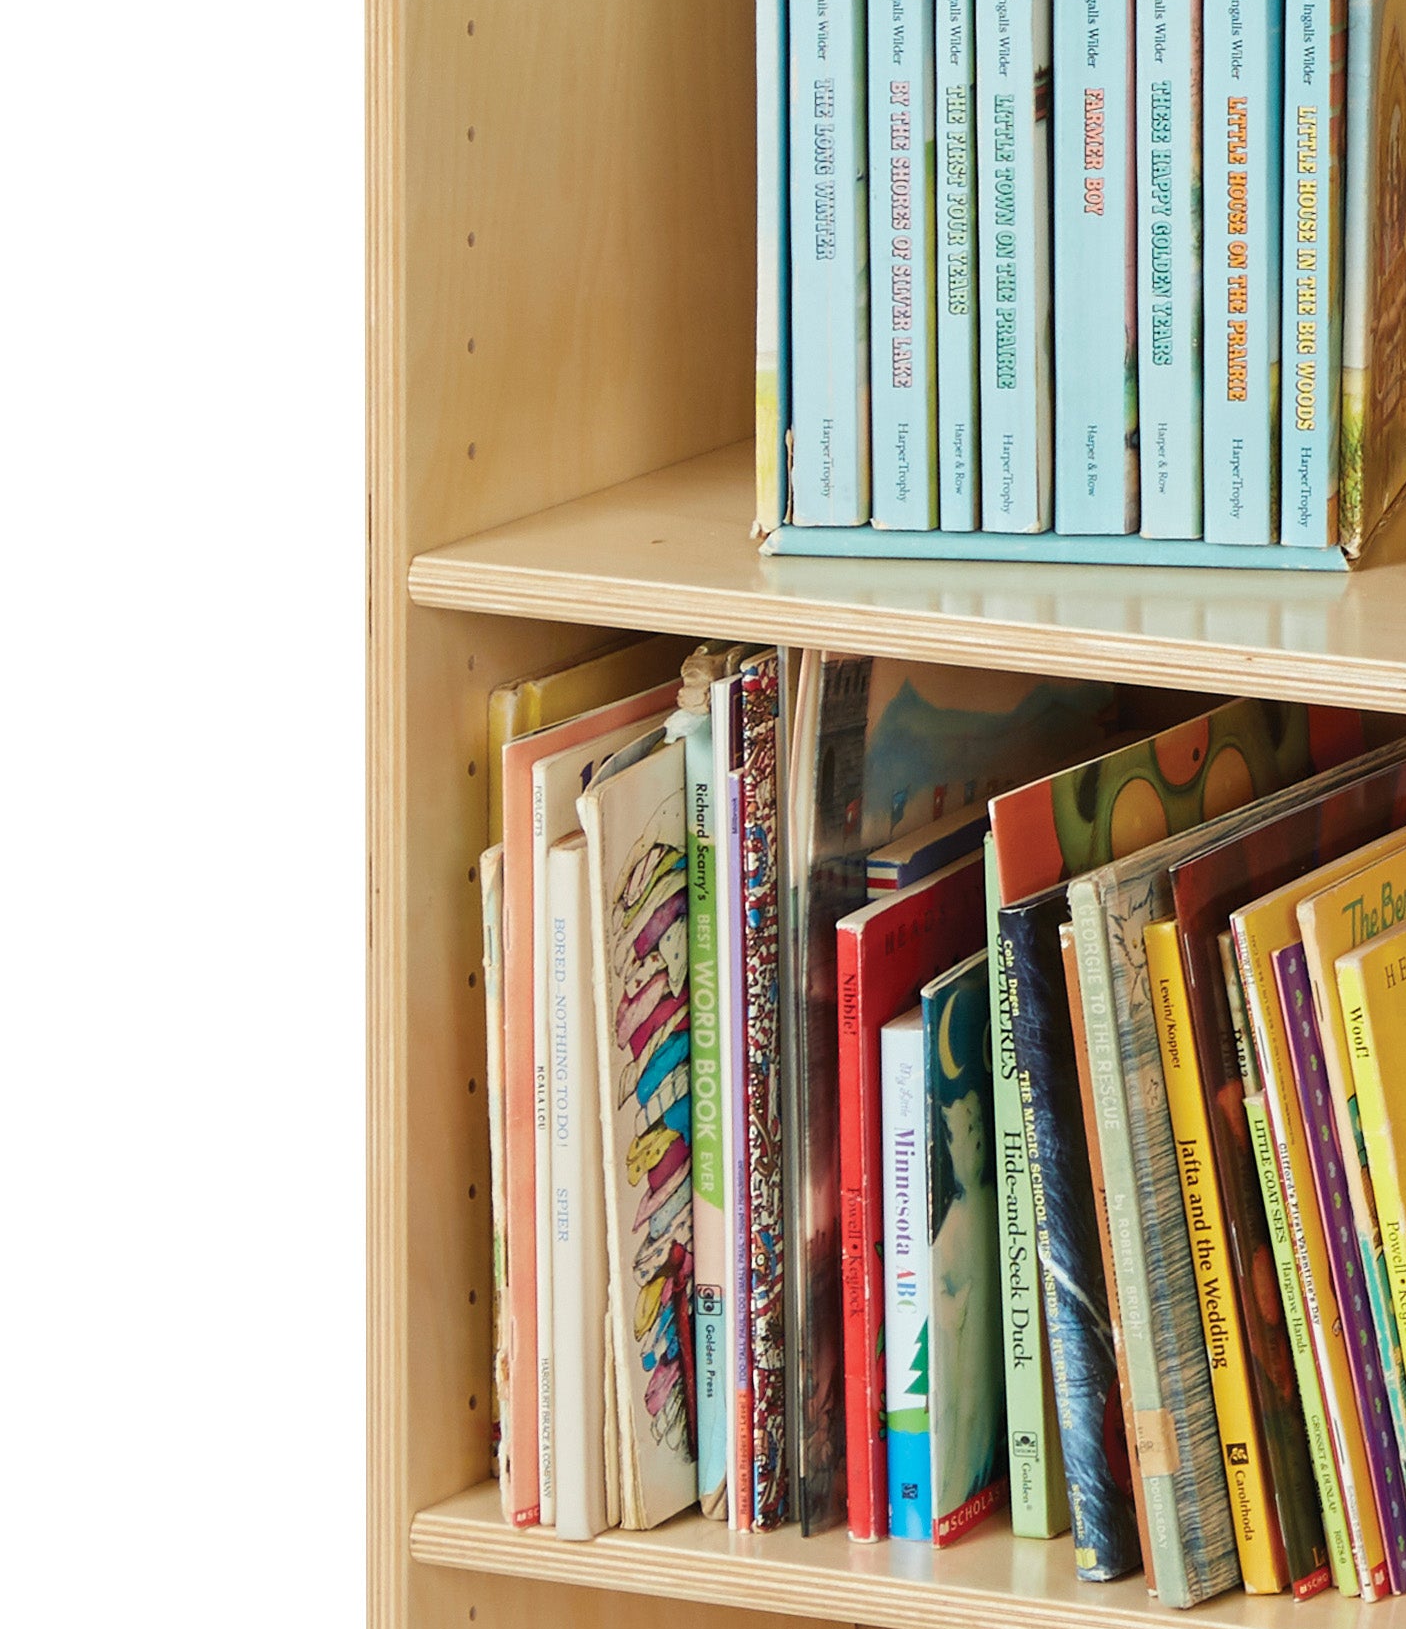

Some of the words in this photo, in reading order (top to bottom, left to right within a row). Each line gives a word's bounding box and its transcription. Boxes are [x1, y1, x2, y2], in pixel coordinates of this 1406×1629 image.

[1084, 88, 1105, 171] FARMER
[1228, 96, 1248, 164] LITTLE
[1084, 176, 1105, 216] BOY
[1228, 170, 1249, 235] HOUSE
[1227, 320, 1249, 403] PRAIRIE
[696, 783, 709, 837] Richard
[696, 841, 708, 901] Scarry's
[552, 917, 566, 983] BORED
[693, 959, 716, 1049] WORD
[1349, 1007, 1370, 1058] Woof!
[700, 1151, 714, 1192] EVER
[894, 1128, 915, 1256] Minnesota
[556, 1188, 569, 1243] SPIER
[1003, 1131, 1028, 1295] Hide-and-Seek
[1078, 904, 1098, 987] GEORGE
[1150, 1476, 1169, 1549] DOUBLEDAY
[1159, 978, 1181, 1071] Lewin/Kopper
[1203, 1276, 1230, 1370] Wedding
[1234, 1470, 1253, 1542] Carolrhoda
[705, 1324, 715, 1366] Golden
[1010, 1308, 1033, 1369] Duck
[706, 1369, 714, 1398] Press
